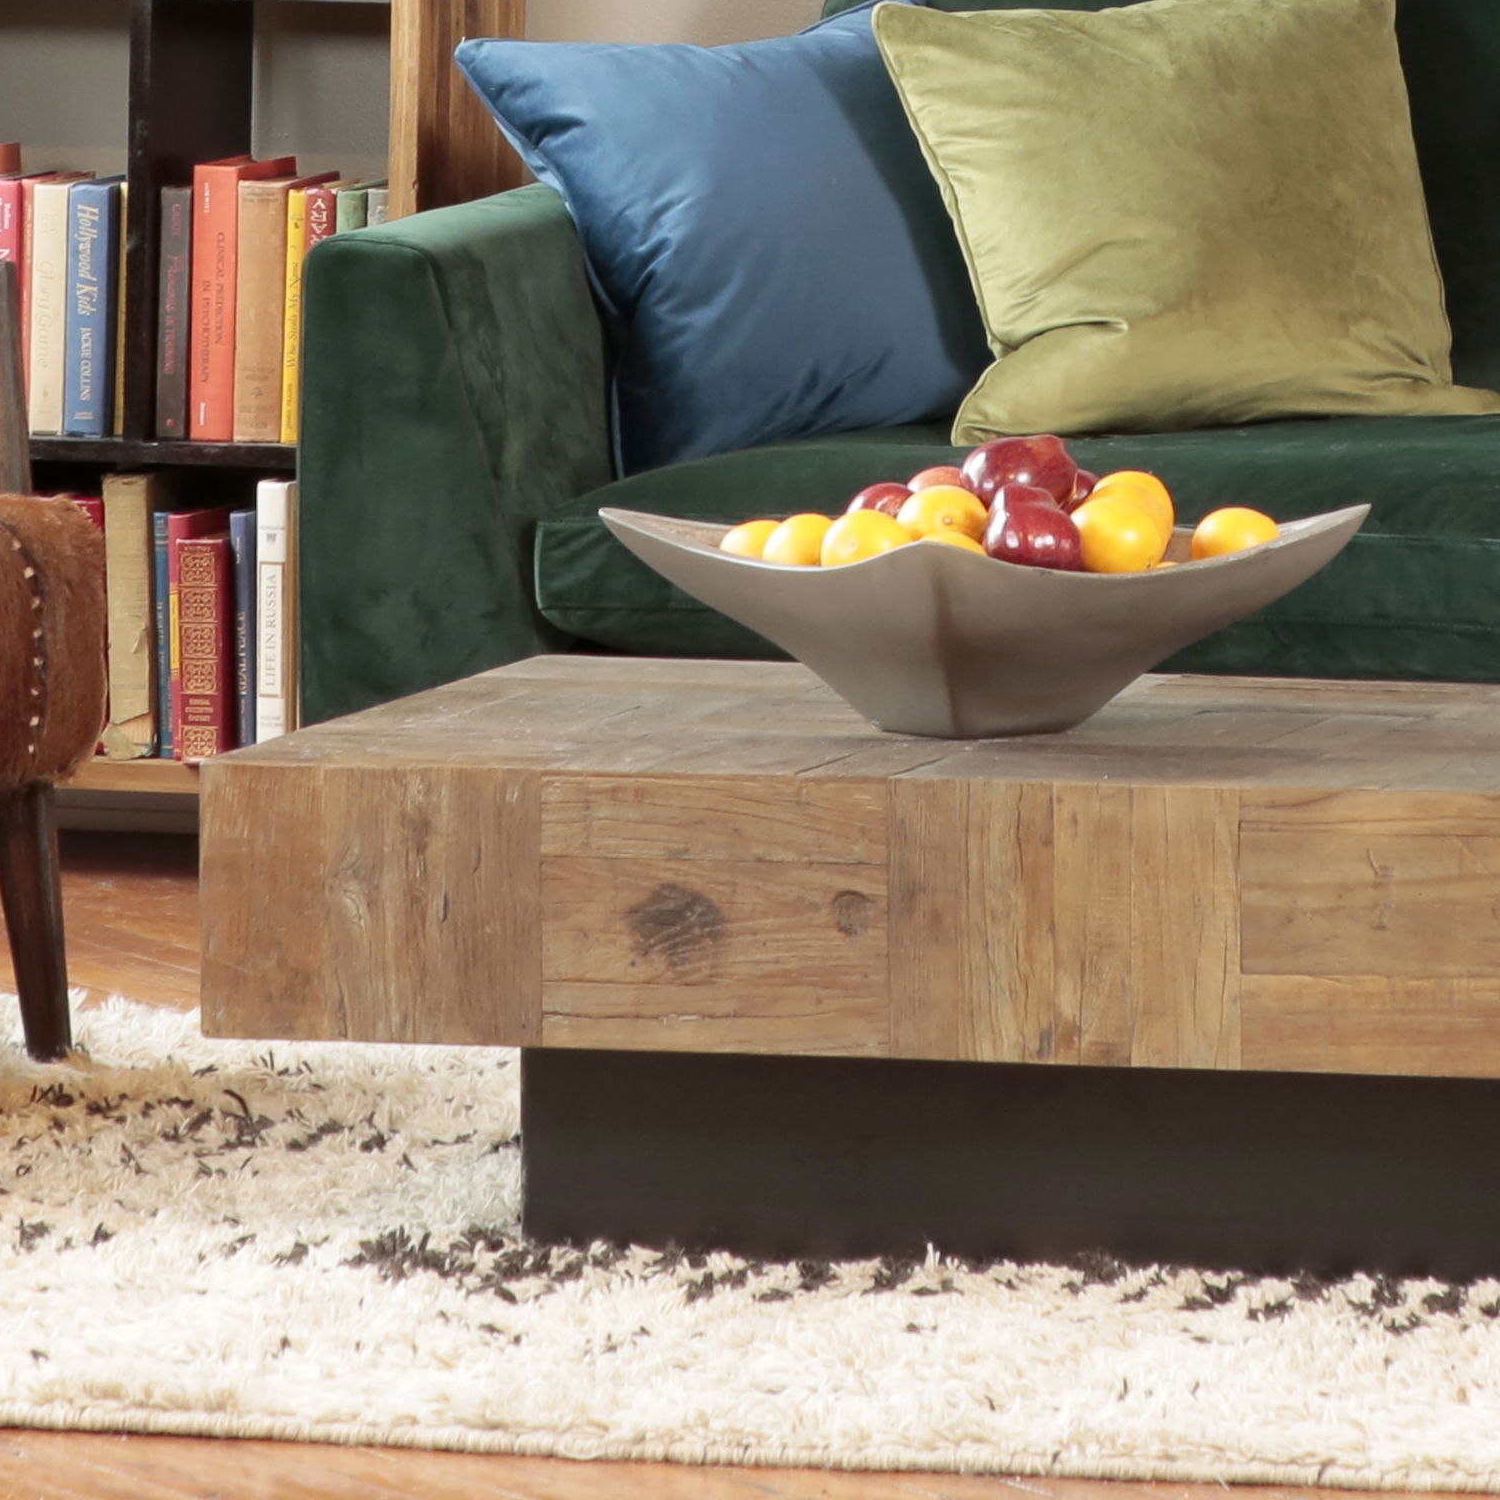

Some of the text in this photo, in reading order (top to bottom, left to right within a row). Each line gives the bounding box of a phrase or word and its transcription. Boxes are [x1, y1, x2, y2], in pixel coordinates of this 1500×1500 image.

[75, 203, 100, 317] Hollywood Kids
[215, 232, 225, 345] CLINICAL PREDICTION
[36, 313, 55, 367] Game
[80, 327, 94, 401] JACKIE COLLINS
[200, 280, 211, 383] IN PSYCHOTHERAPY
[285, 262, 300, 369] Who My Name
[237, 612, 247, 696] REAL PEACE
[264, 574, 277, 687] LIFE IN RUSSIA
